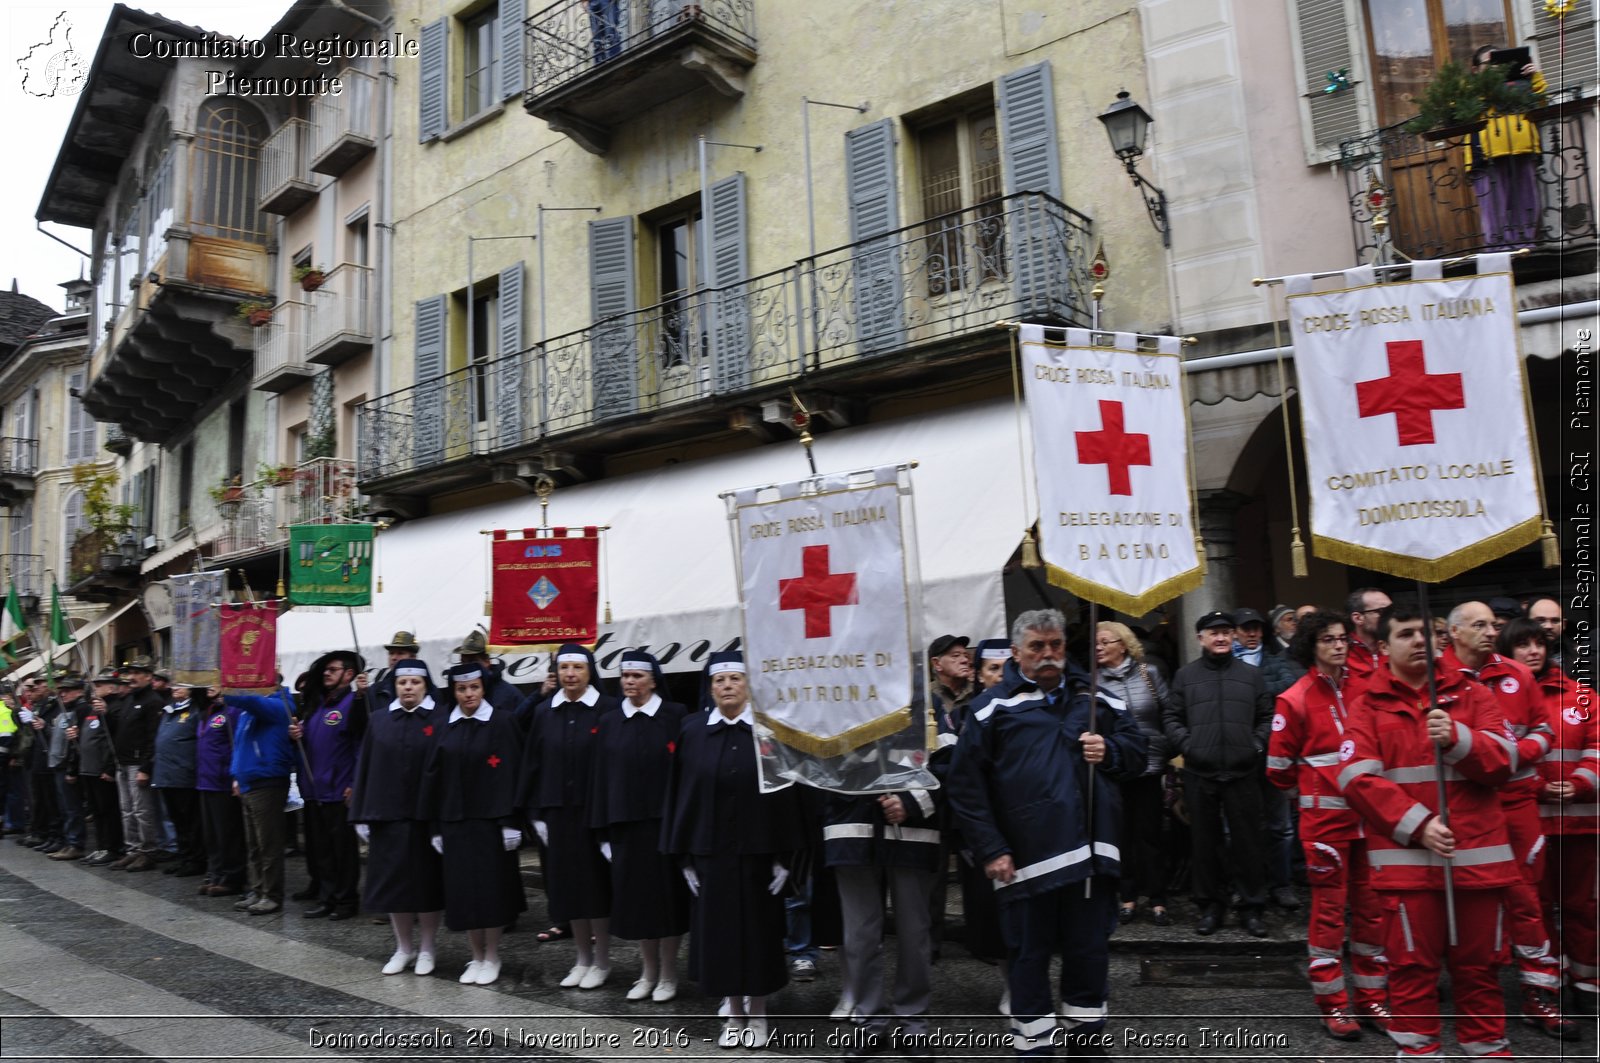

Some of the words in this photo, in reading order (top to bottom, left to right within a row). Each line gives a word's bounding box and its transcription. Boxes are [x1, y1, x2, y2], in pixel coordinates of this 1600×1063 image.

[1302, 313, 1352, 333] CROCE
[1359, 305, 1412, 327] ROSSA
[1421, 297, 1496, 321] ITALIANA
[1034, 364, 1071, 384] CROCE
[1076, 368, 1116, 386] ROSSA
[1121, 371, 1173, 390] ITALIANA
[1327, 463, 1428, 491] COMITATO
[1438, 459, 1515, 481] LOCALE
[750, 519, 781, 540] CROCE
[787, 513, 825, 535] ROSSA
[831, 505, 887, 528] ITALIANA
[1059, 512, 1162, 528] DELEGAZIONE
[1168, 512, 1183, 528] DI
[1358, 498, 1488, 527] DOMODOSSOLA
[1079, 543, 1170, 561] BACENO
[762, 653, 866, 674] DELEGAZIONE
[874, 651, 892, 667] DI
[777, 684, 879, 703] ANTRONA
